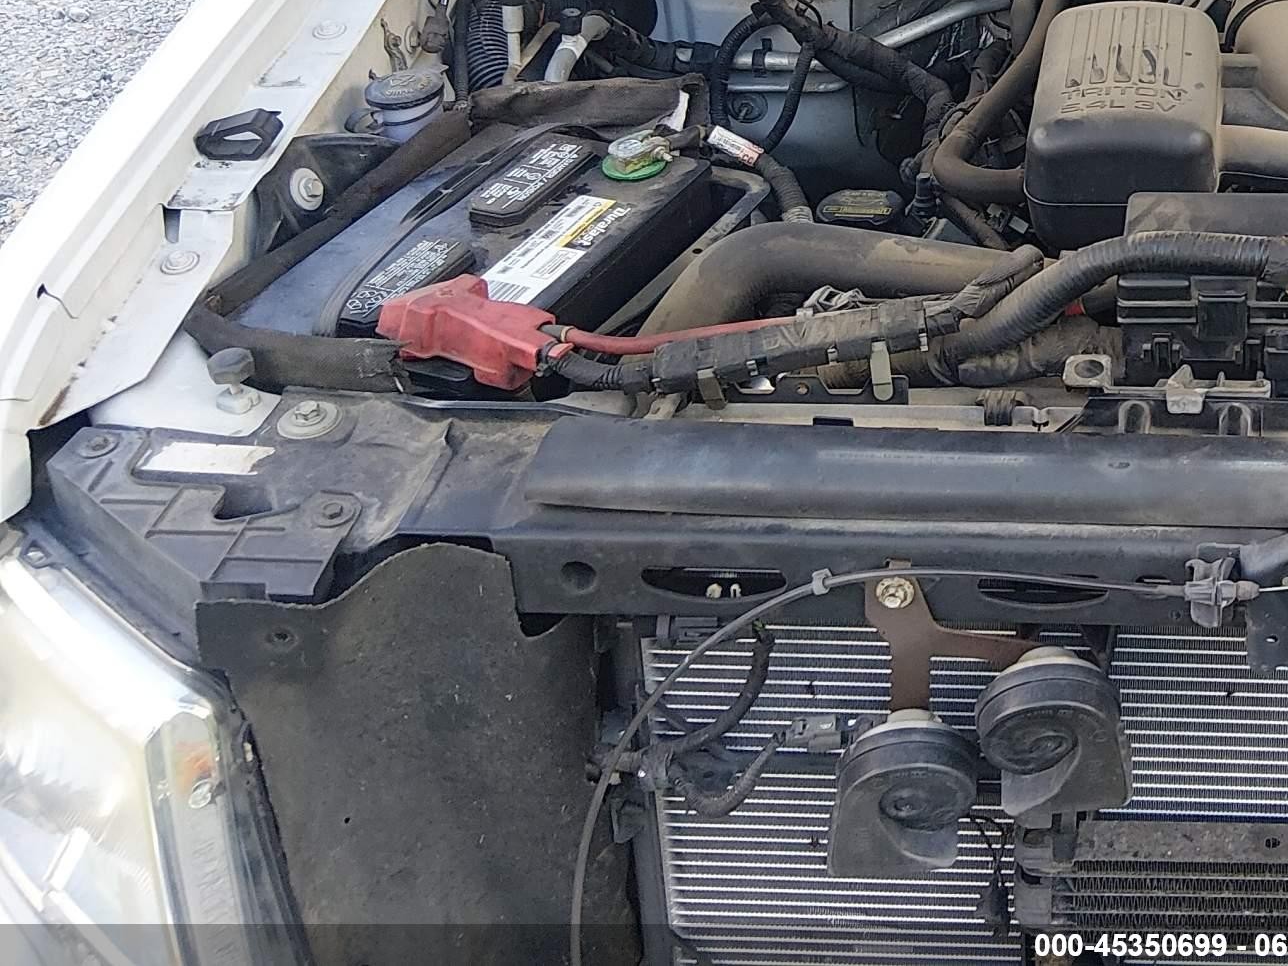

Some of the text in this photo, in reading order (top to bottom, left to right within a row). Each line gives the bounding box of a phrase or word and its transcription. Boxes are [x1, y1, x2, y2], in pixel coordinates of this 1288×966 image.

[1061, 86, 1187, 100] TRITON
[1061, 100, 1177, 113] 5.4L 3V
[578, 205, 631, 246] Duralast
